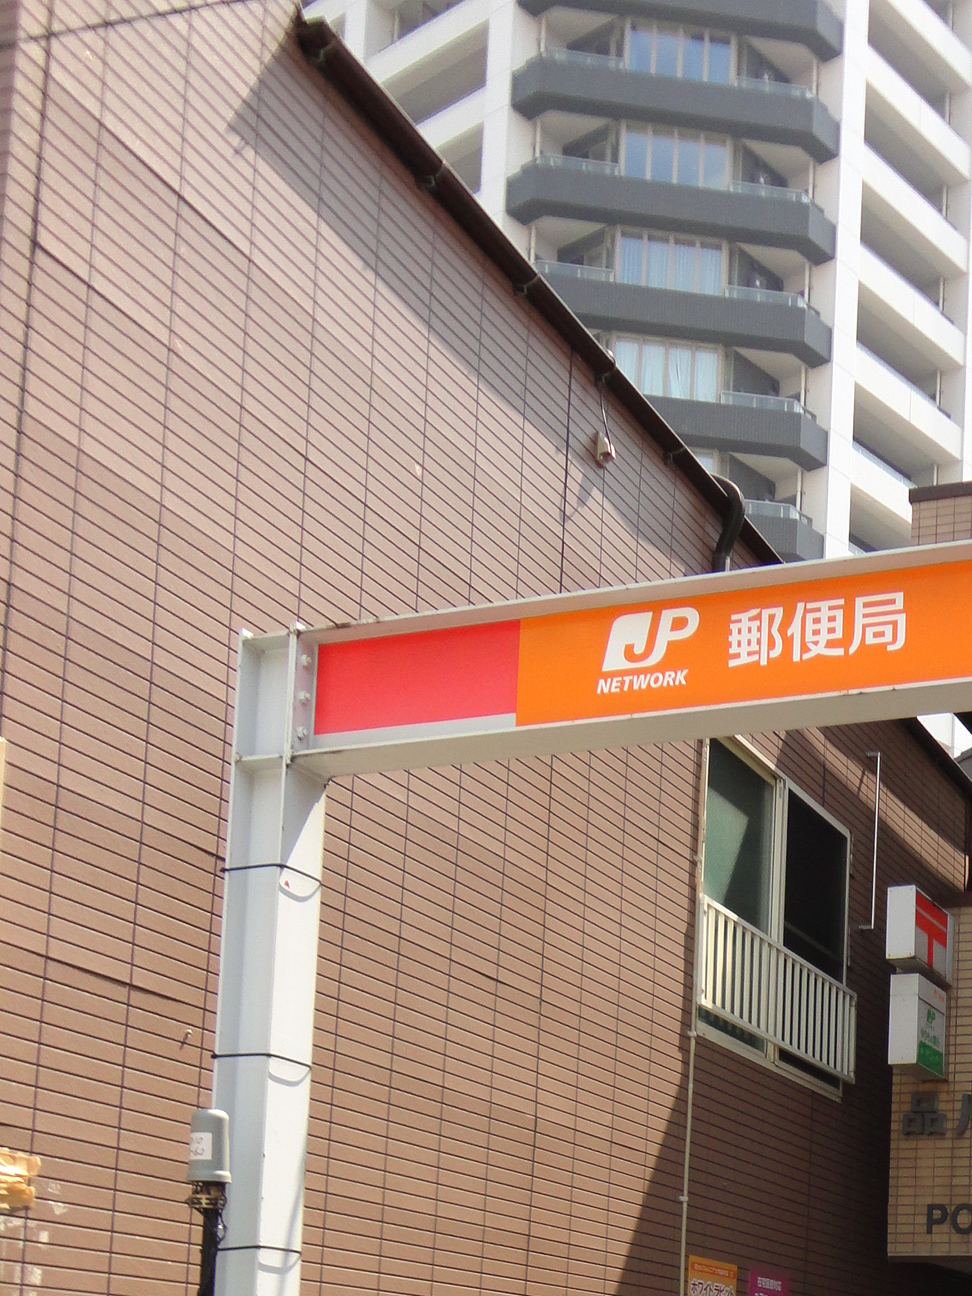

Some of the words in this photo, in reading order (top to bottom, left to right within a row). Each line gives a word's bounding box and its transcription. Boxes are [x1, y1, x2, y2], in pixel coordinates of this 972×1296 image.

[728, 591, 907, 668] 郵便局
[596, 669, 689, 695] NETWORK
